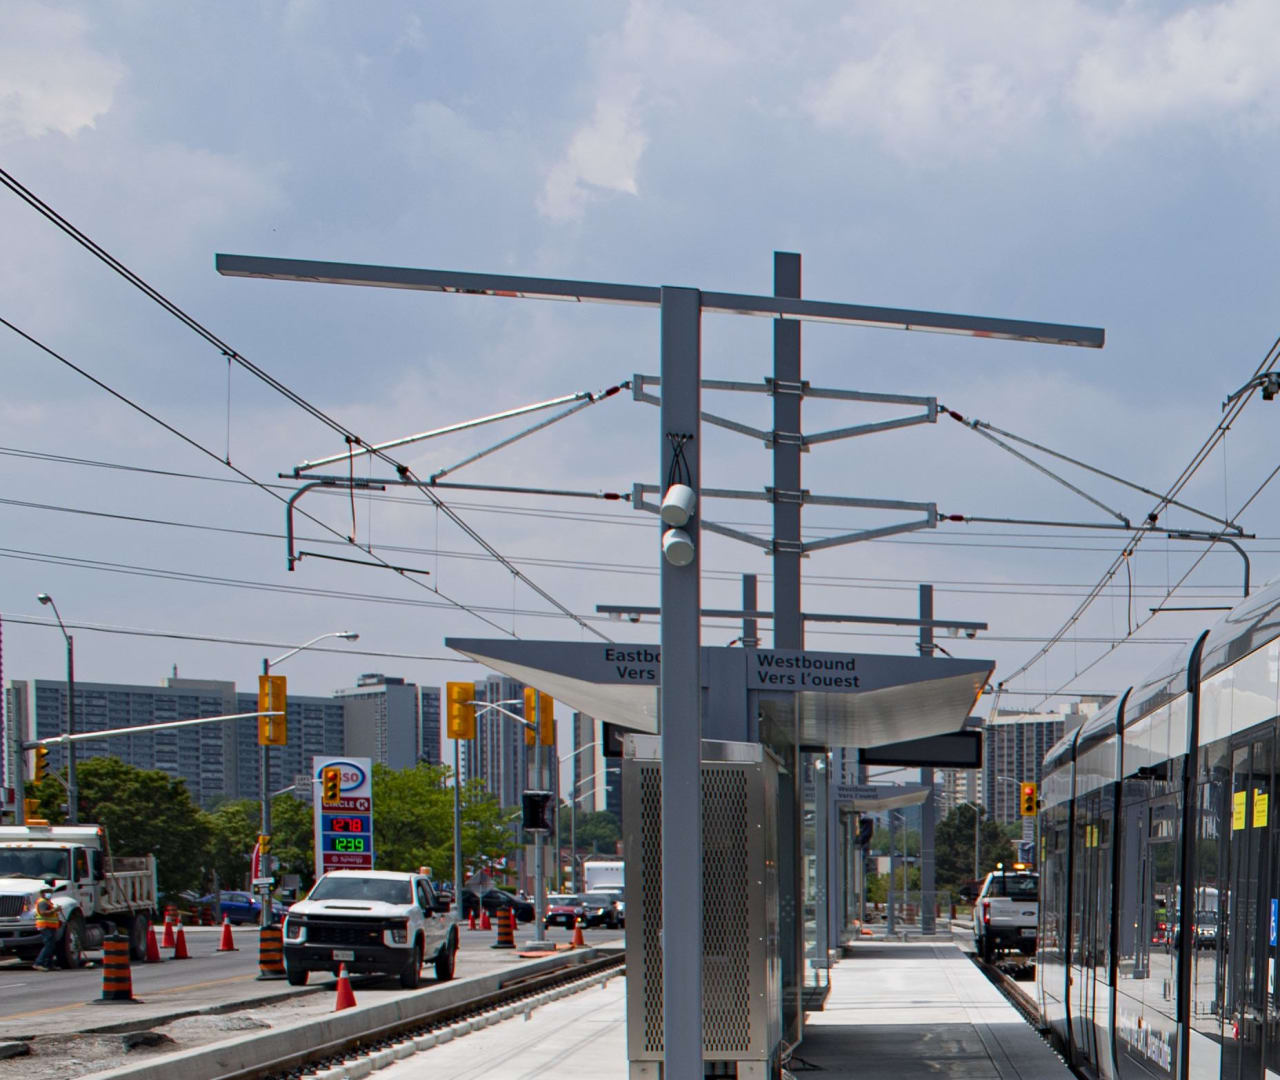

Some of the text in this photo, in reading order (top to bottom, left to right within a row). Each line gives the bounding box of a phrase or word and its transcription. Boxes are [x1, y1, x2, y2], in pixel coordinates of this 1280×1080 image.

[605, 648, 662, 664] Eastbo
[756, 653, 856, 672] Westbound
[616, 665, 656, 680] Vers
[757, 670, 796, 685] Vers
